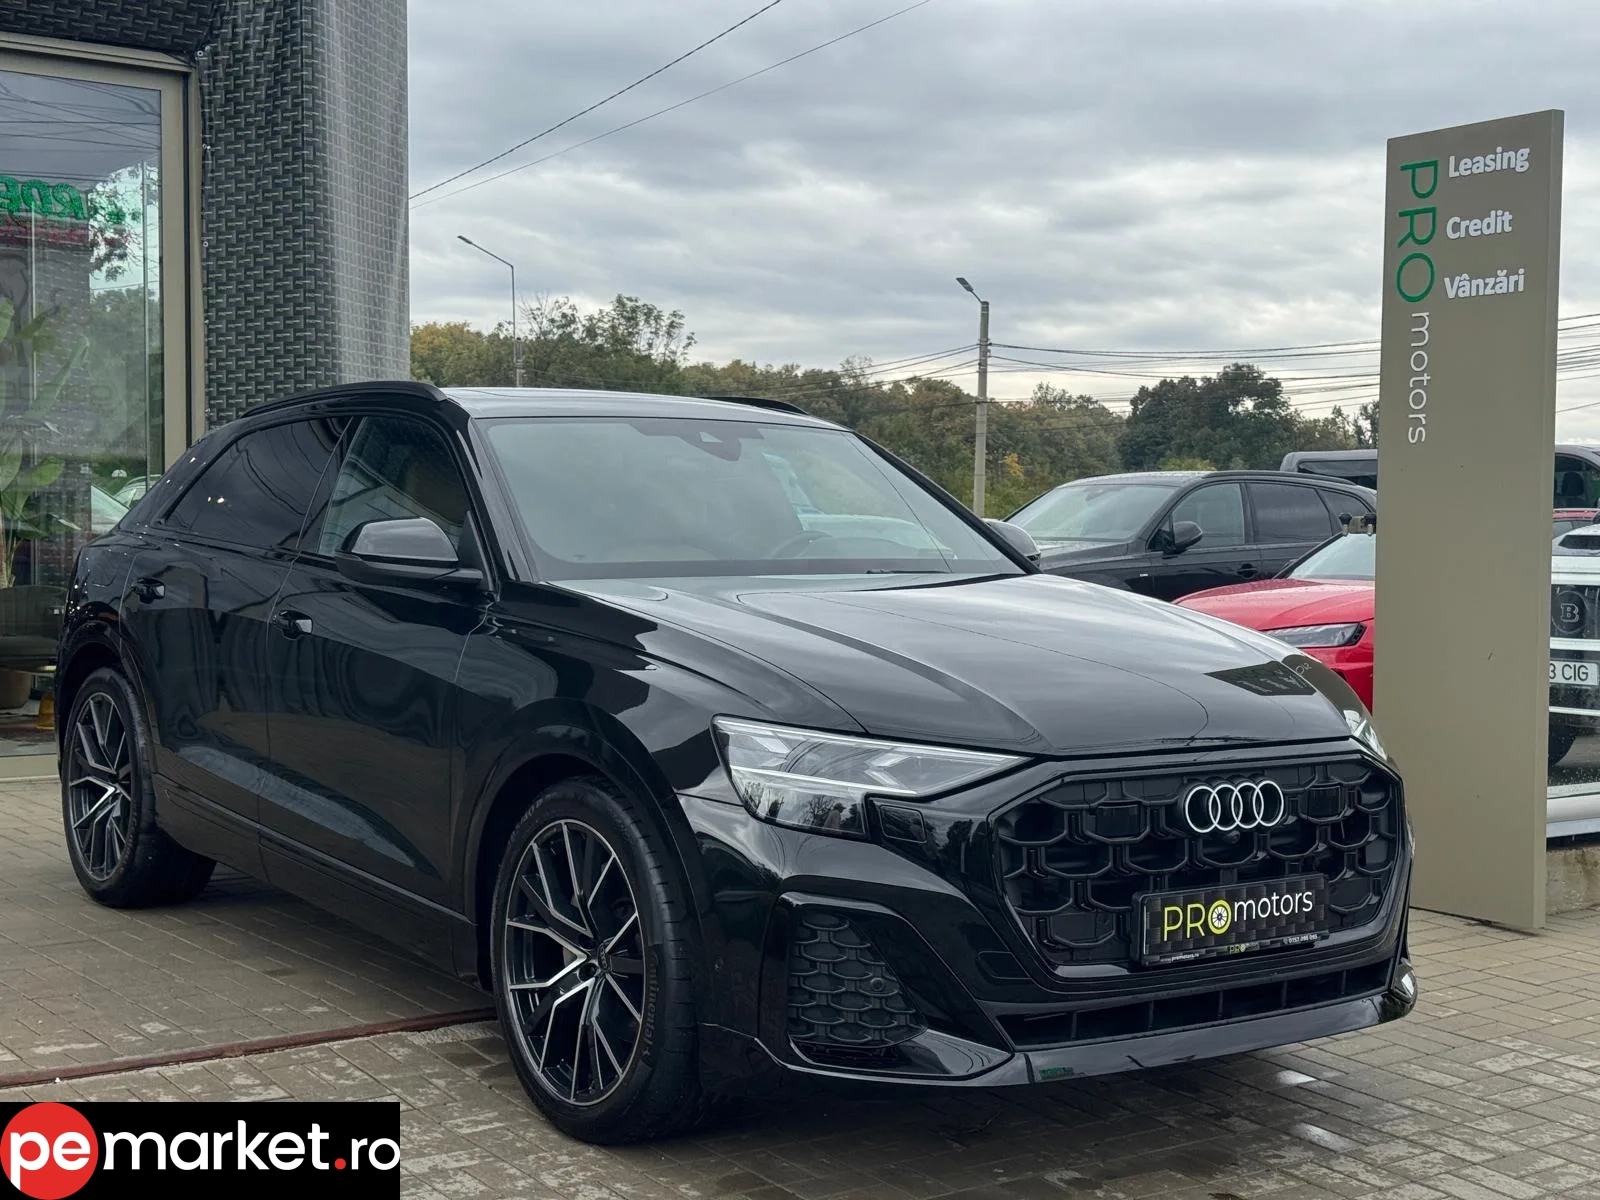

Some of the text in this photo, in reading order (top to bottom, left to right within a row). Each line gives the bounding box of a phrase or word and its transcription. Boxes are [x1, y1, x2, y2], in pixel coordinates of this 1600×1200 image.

[1448, 147, 1531, 178] Leasing
[1446, 209, 1513, 240] Credit
[1443, 268, 1526, 300] Vânzări
[1560, 602, 1579, 623] B
[1561, 664, 1589, 682] CIG
